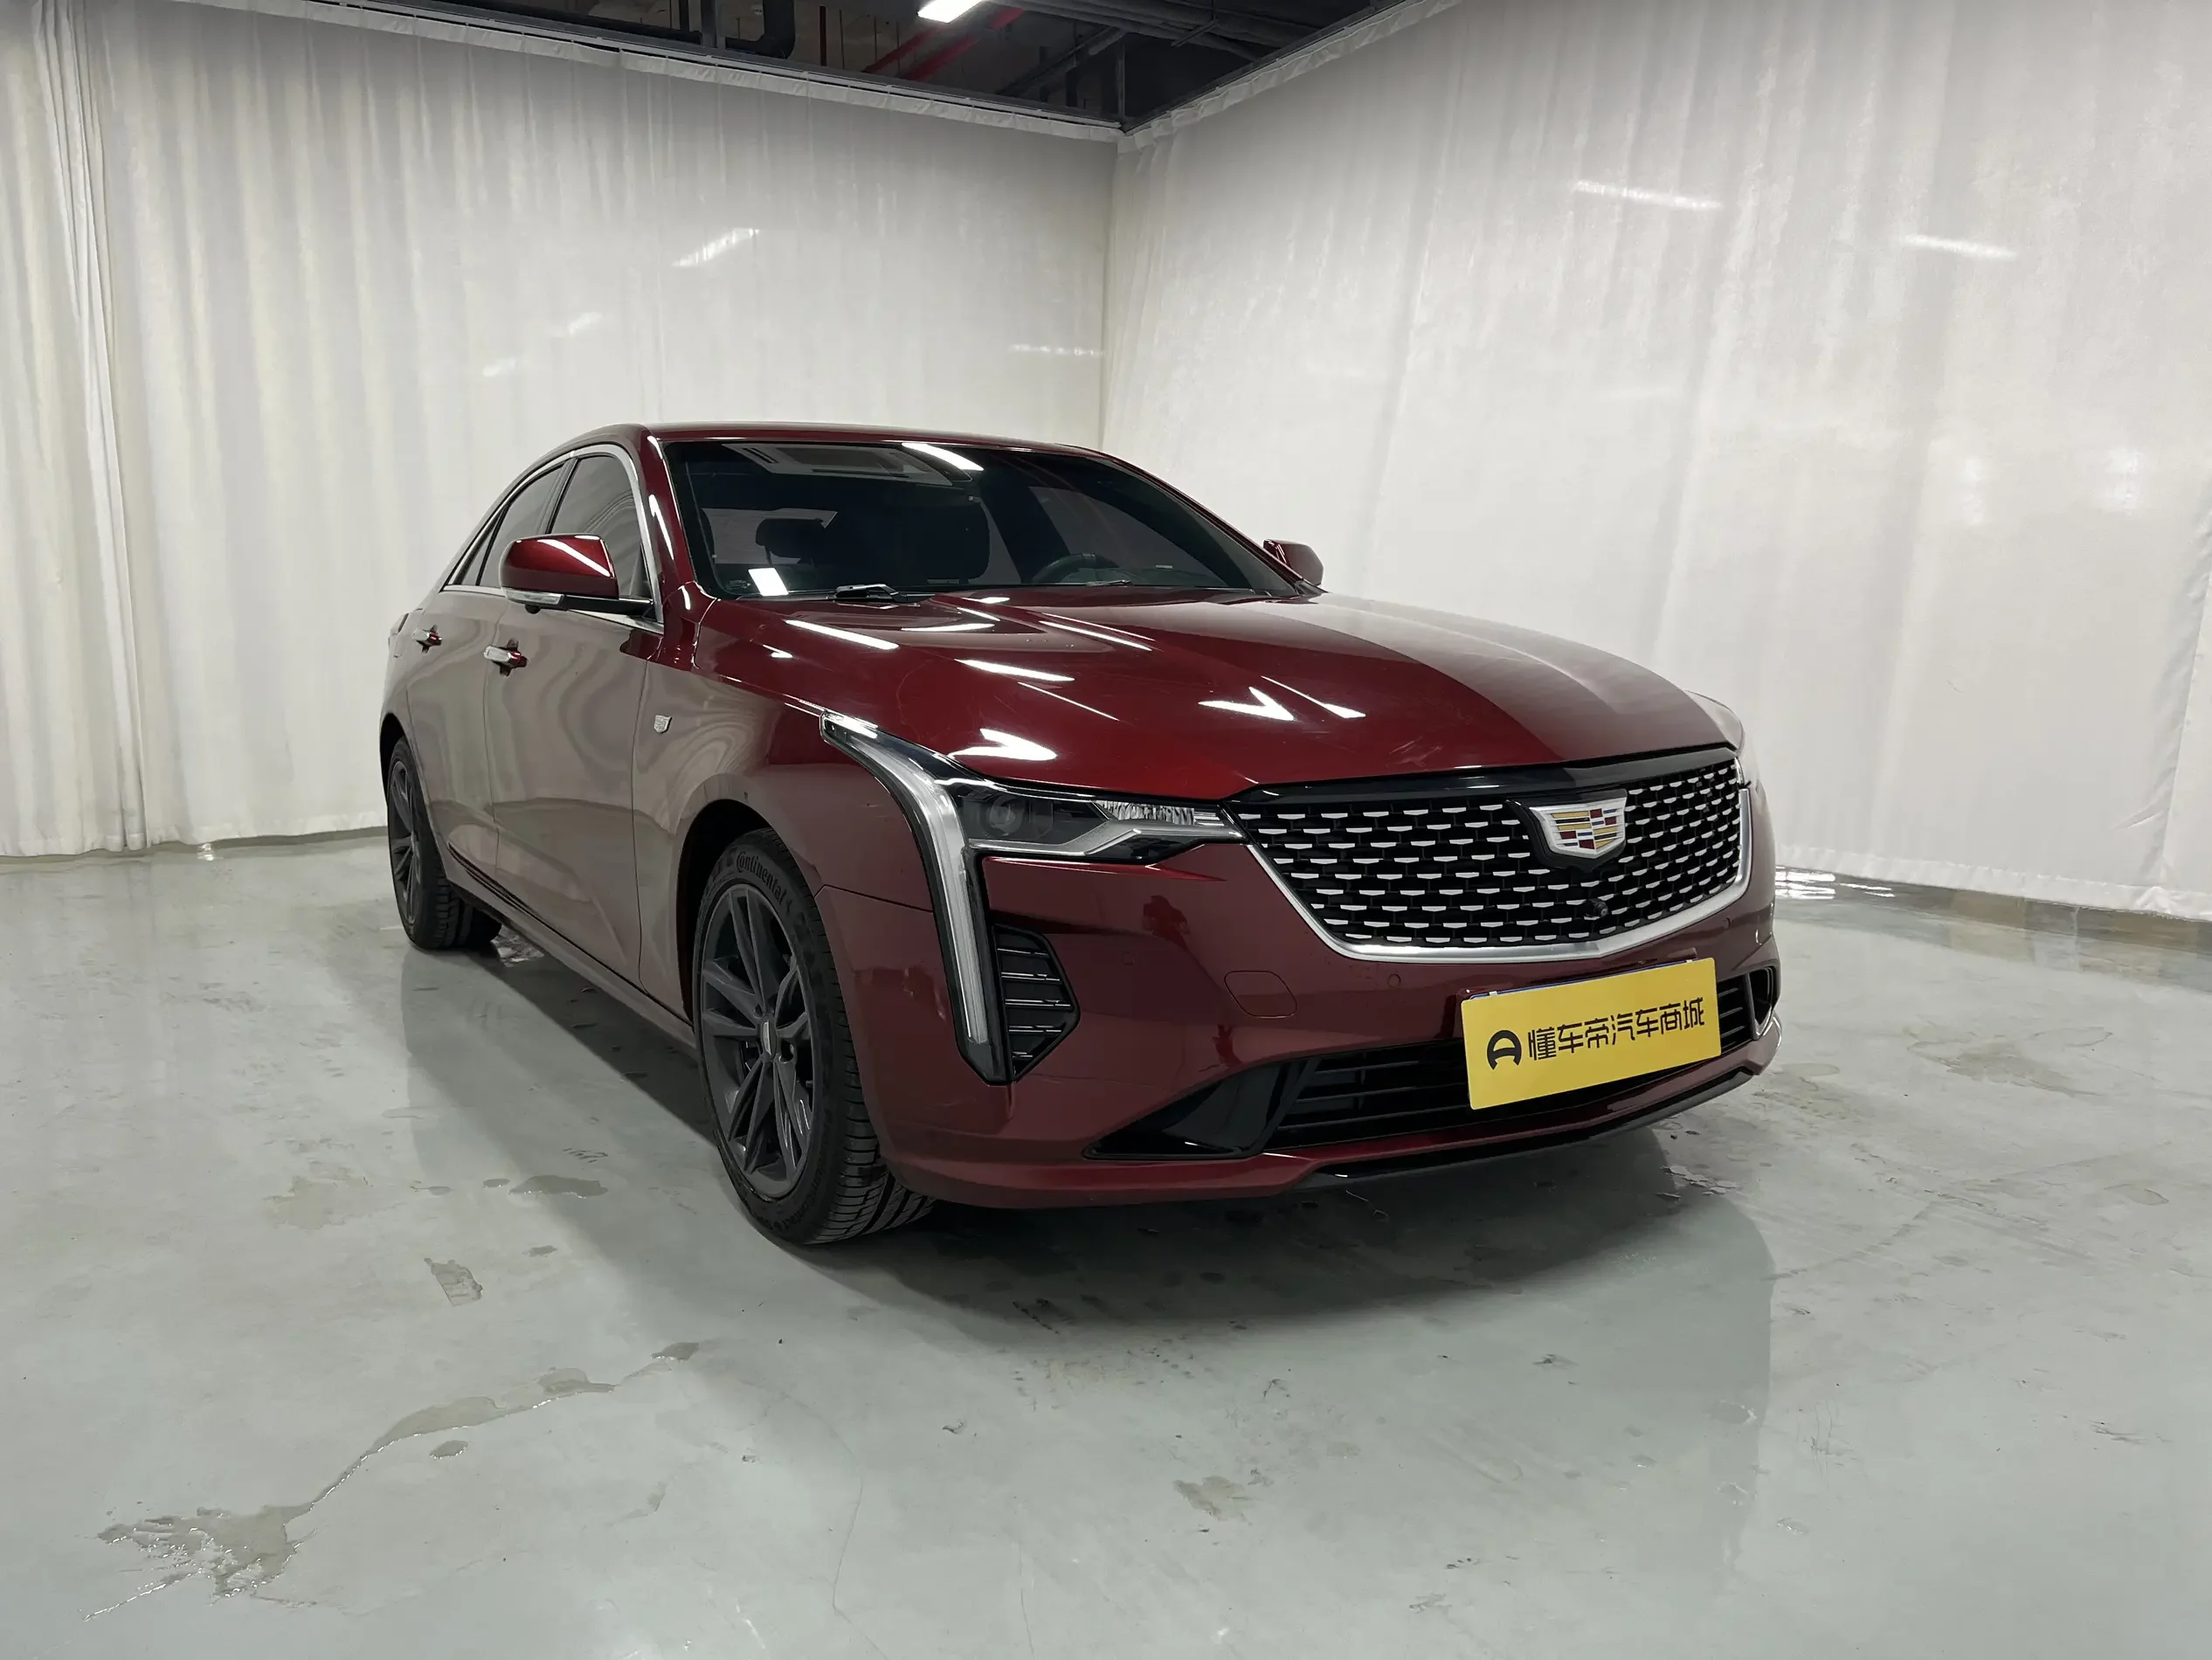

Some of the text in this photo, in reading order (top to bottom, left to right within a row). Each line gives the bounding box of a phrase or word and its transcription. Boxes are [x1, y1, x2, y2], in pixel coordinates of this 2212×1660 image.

[736, 851, 787, 906] Continental
[1528, 997, 1705, 1062] 懂车帝汽车商城
